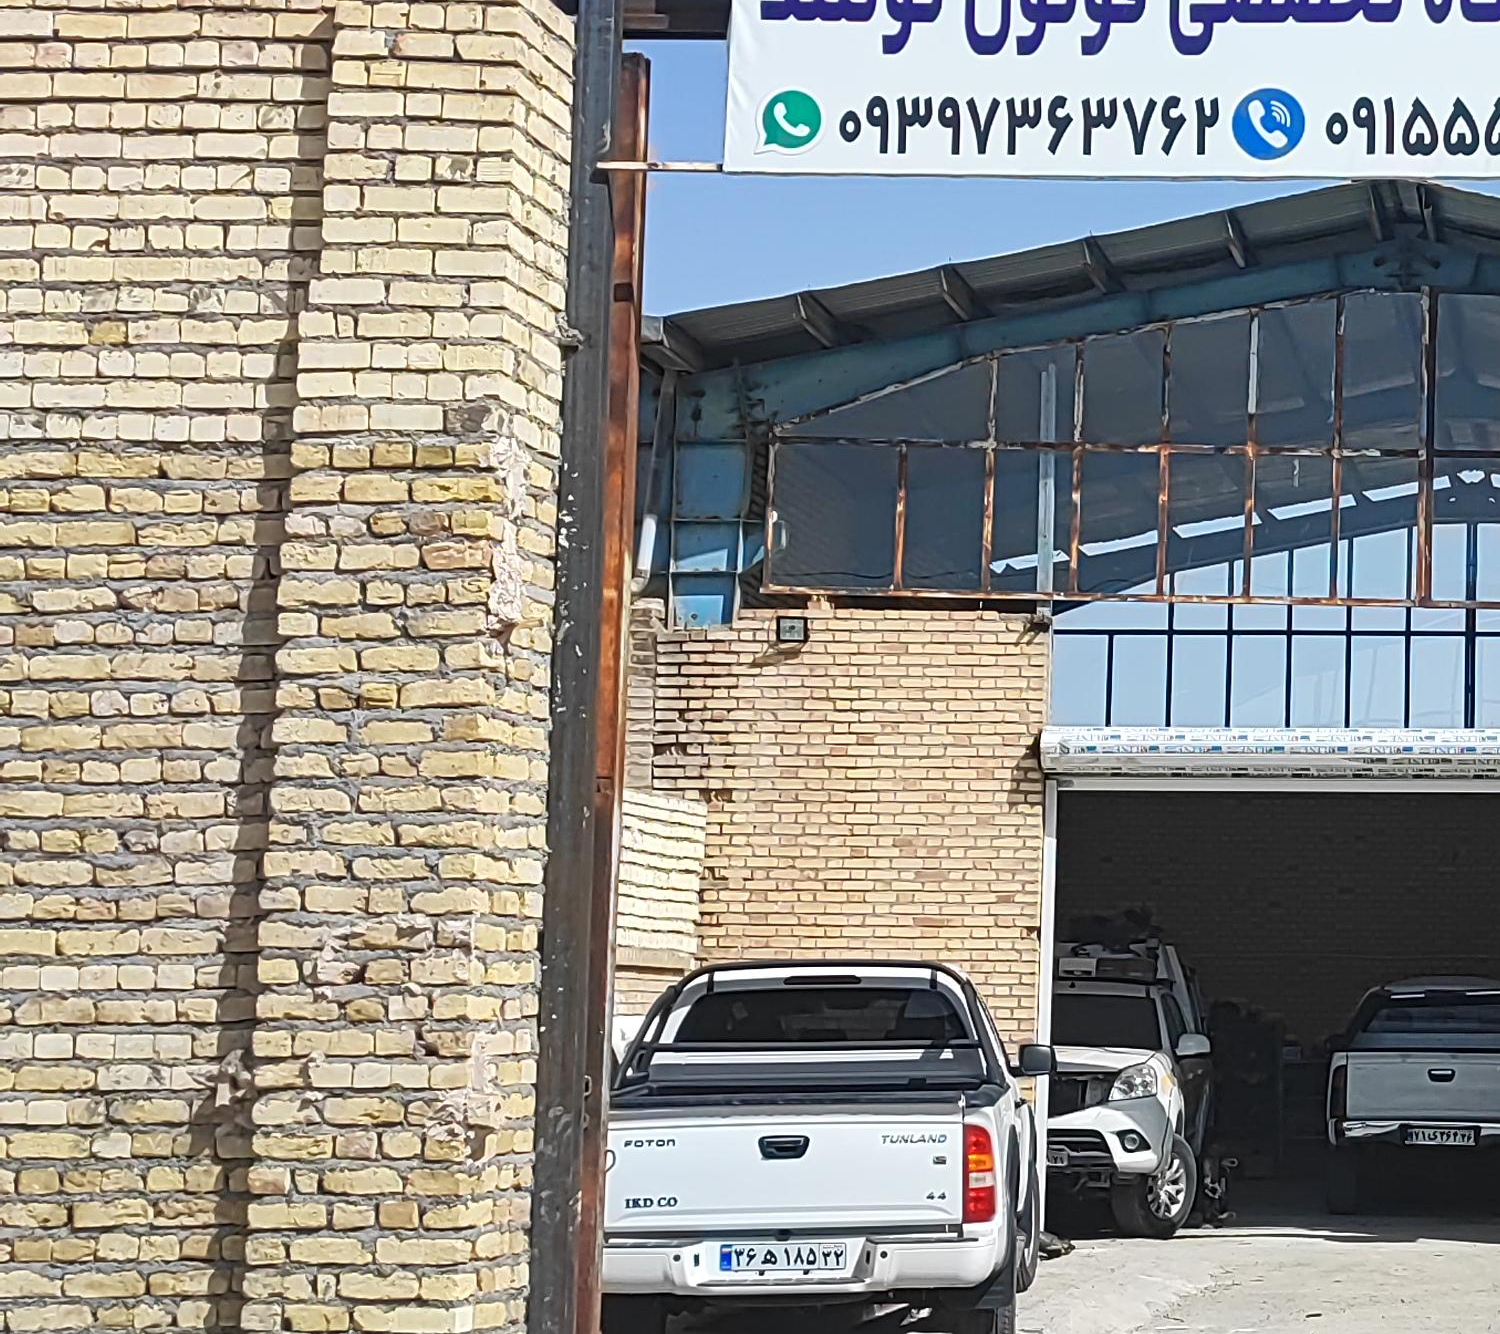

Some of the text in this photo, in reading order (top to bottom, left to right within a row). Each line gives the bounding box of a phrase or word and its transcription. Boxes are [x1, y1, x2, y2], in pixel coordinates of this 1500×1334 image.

[839, 95, 1220, 157] ۰۹۳۹۷۳۶۳۷۶۲
[624, 1139, 676, 1148] FOTON
[881, 1134, 947, 1144] TUNLAND
[624, 1196, 678, 1209] IKD CO
